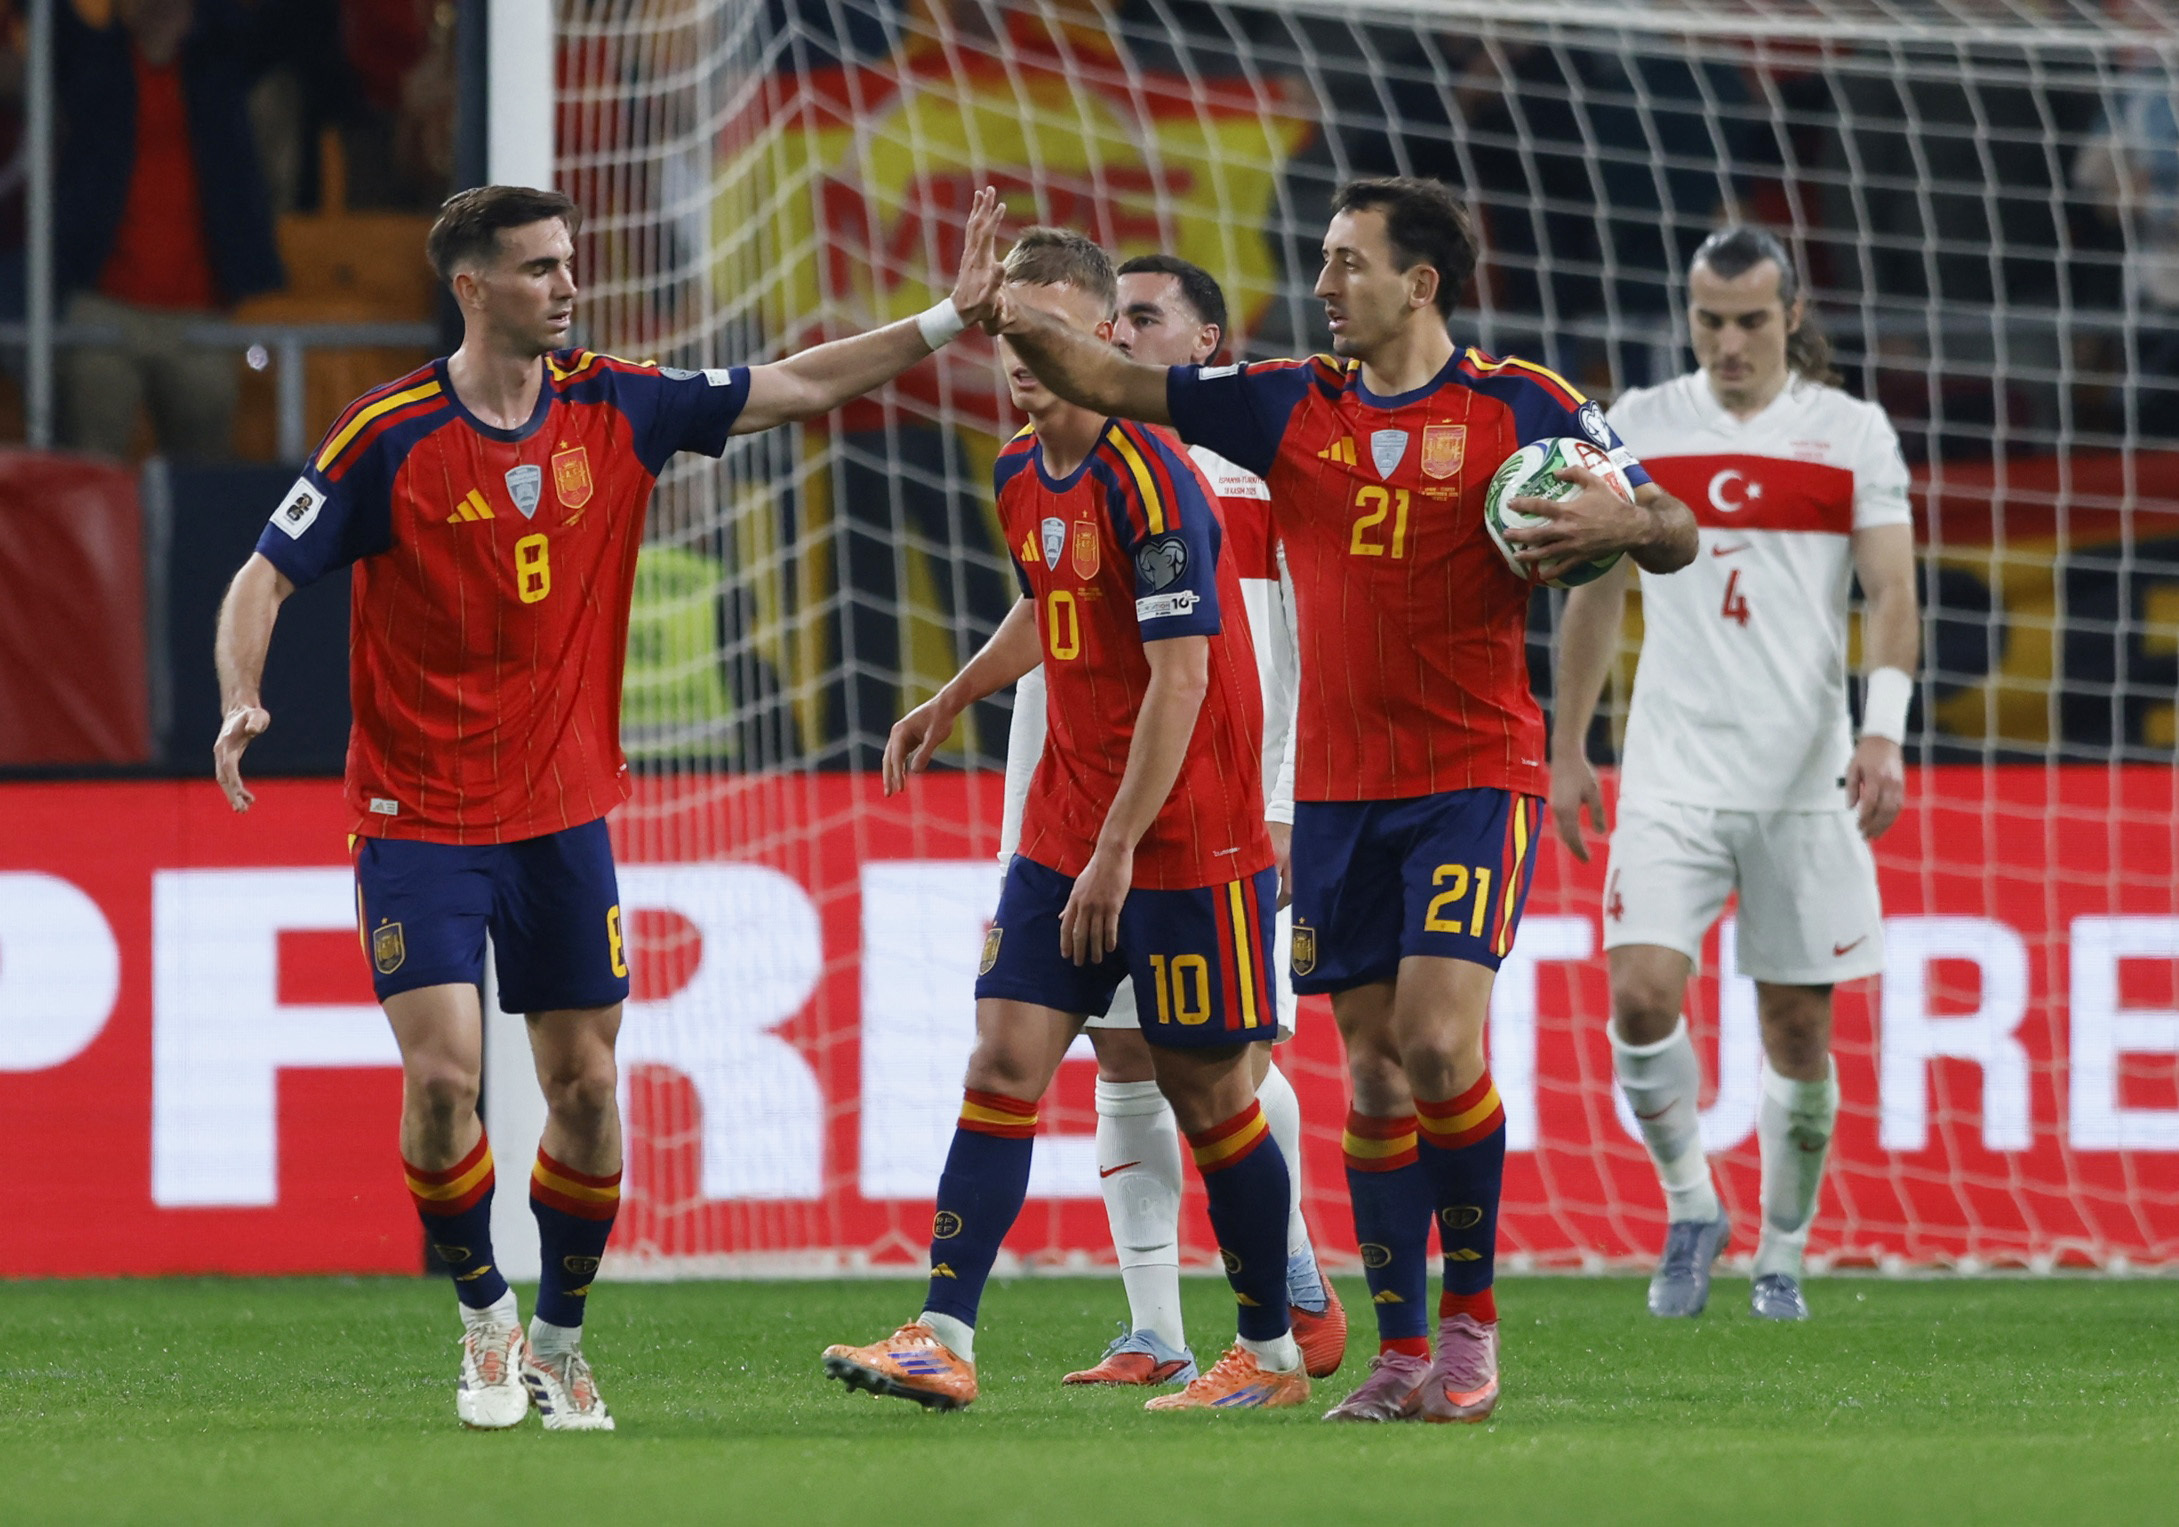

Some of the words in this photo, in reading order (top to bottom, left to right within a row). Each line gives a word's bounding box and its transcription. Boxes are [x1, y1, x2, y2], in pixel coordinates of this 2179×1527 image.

[1349, 485, 1411, 560] 21
[514, 533, 551, 604] 8
[1721, 570, 1750, 628] 4
[1048, 590, 1080, 660] 0
[1424, 863, 1492, 938] 21
[1149, 954, 1212, 1026] 10
